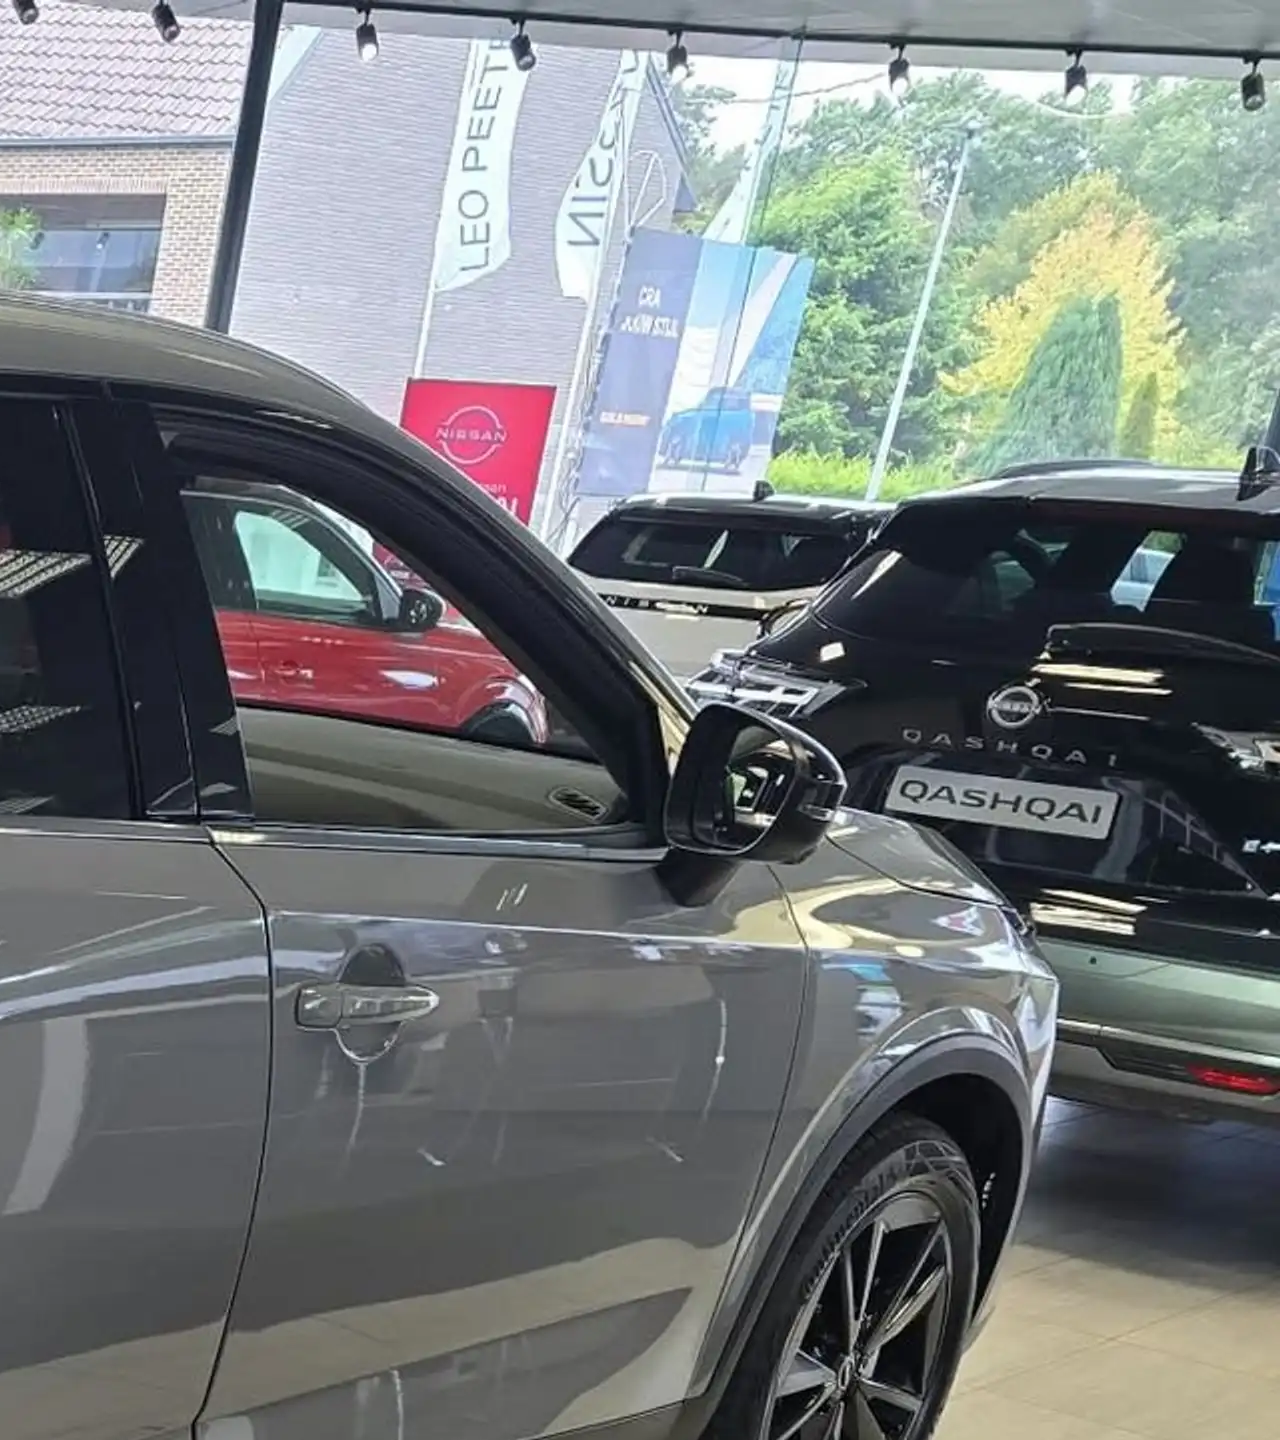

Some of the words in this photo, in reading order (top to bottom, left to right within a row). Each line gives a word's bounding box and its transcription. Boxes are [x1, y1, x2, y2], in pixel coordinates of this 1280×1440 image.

[458, 189, 491, 272] LEO
[436, 426, 507, 442] NISSAN
[902, 728, 1117, 767] QASHQAI
[899, 779, 1102, 824] QASHQAI
